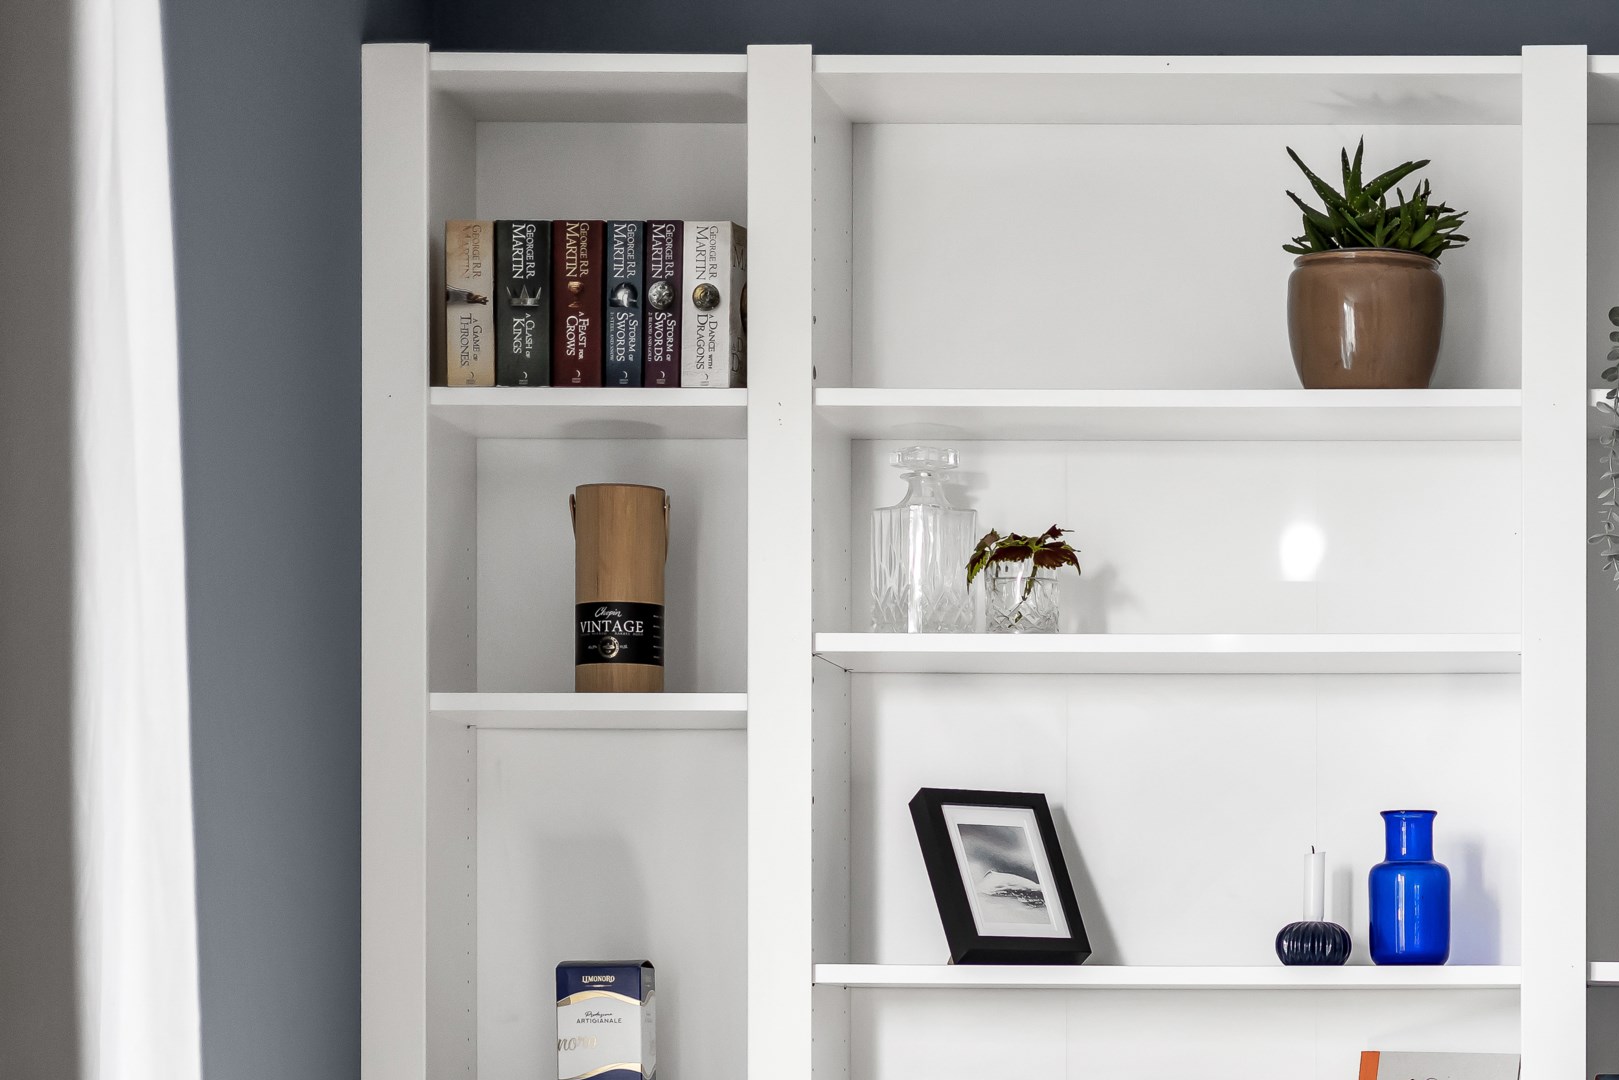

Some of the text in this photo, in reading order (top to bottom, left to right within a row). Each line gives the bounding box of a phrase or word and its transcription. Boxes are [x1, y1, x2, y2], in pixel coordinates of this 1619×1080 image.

[473, 225, 482, 260] GEORGE
[513, 224, 525, 279] MARTIN
[526, 224, 536, 260] GEORGE
[566, 222, 579, 277] MARTIN
[580, 223, 589, 259] GEORGE
[614, 224, 627, 278] MARTIN
[628, 224, 636, 259] GEORGE
[652, 224, 665, 278] MARTIN
[666, 224, 675, 260] GEORGE
[696, 226, 708, 280] MARTIN
[710, 226, 718, 261] GEORGE
[461, 313, 472, 366] THRONES
[473, 325, 482, 352] GAME
[513, 318, 524, 353] KINGS
[526, 321, 535, 348] CLASH
[567, 316, 578, 355] CROWS
[579, 319, 589, 347] FEAST
[616, 312, 628, 361] SWORDS
[629, 320, 638, 351] STORM
[654, 312, 665, 361] SWORDS
[667, 320, 676, 351] STORM
[697, 314, 708, 369] DRAGONS
[709, 321, 718, 352] DANCE
[580, 620, 644, 633] VINTAGE
[595, 606, 622, 619] Chopin
